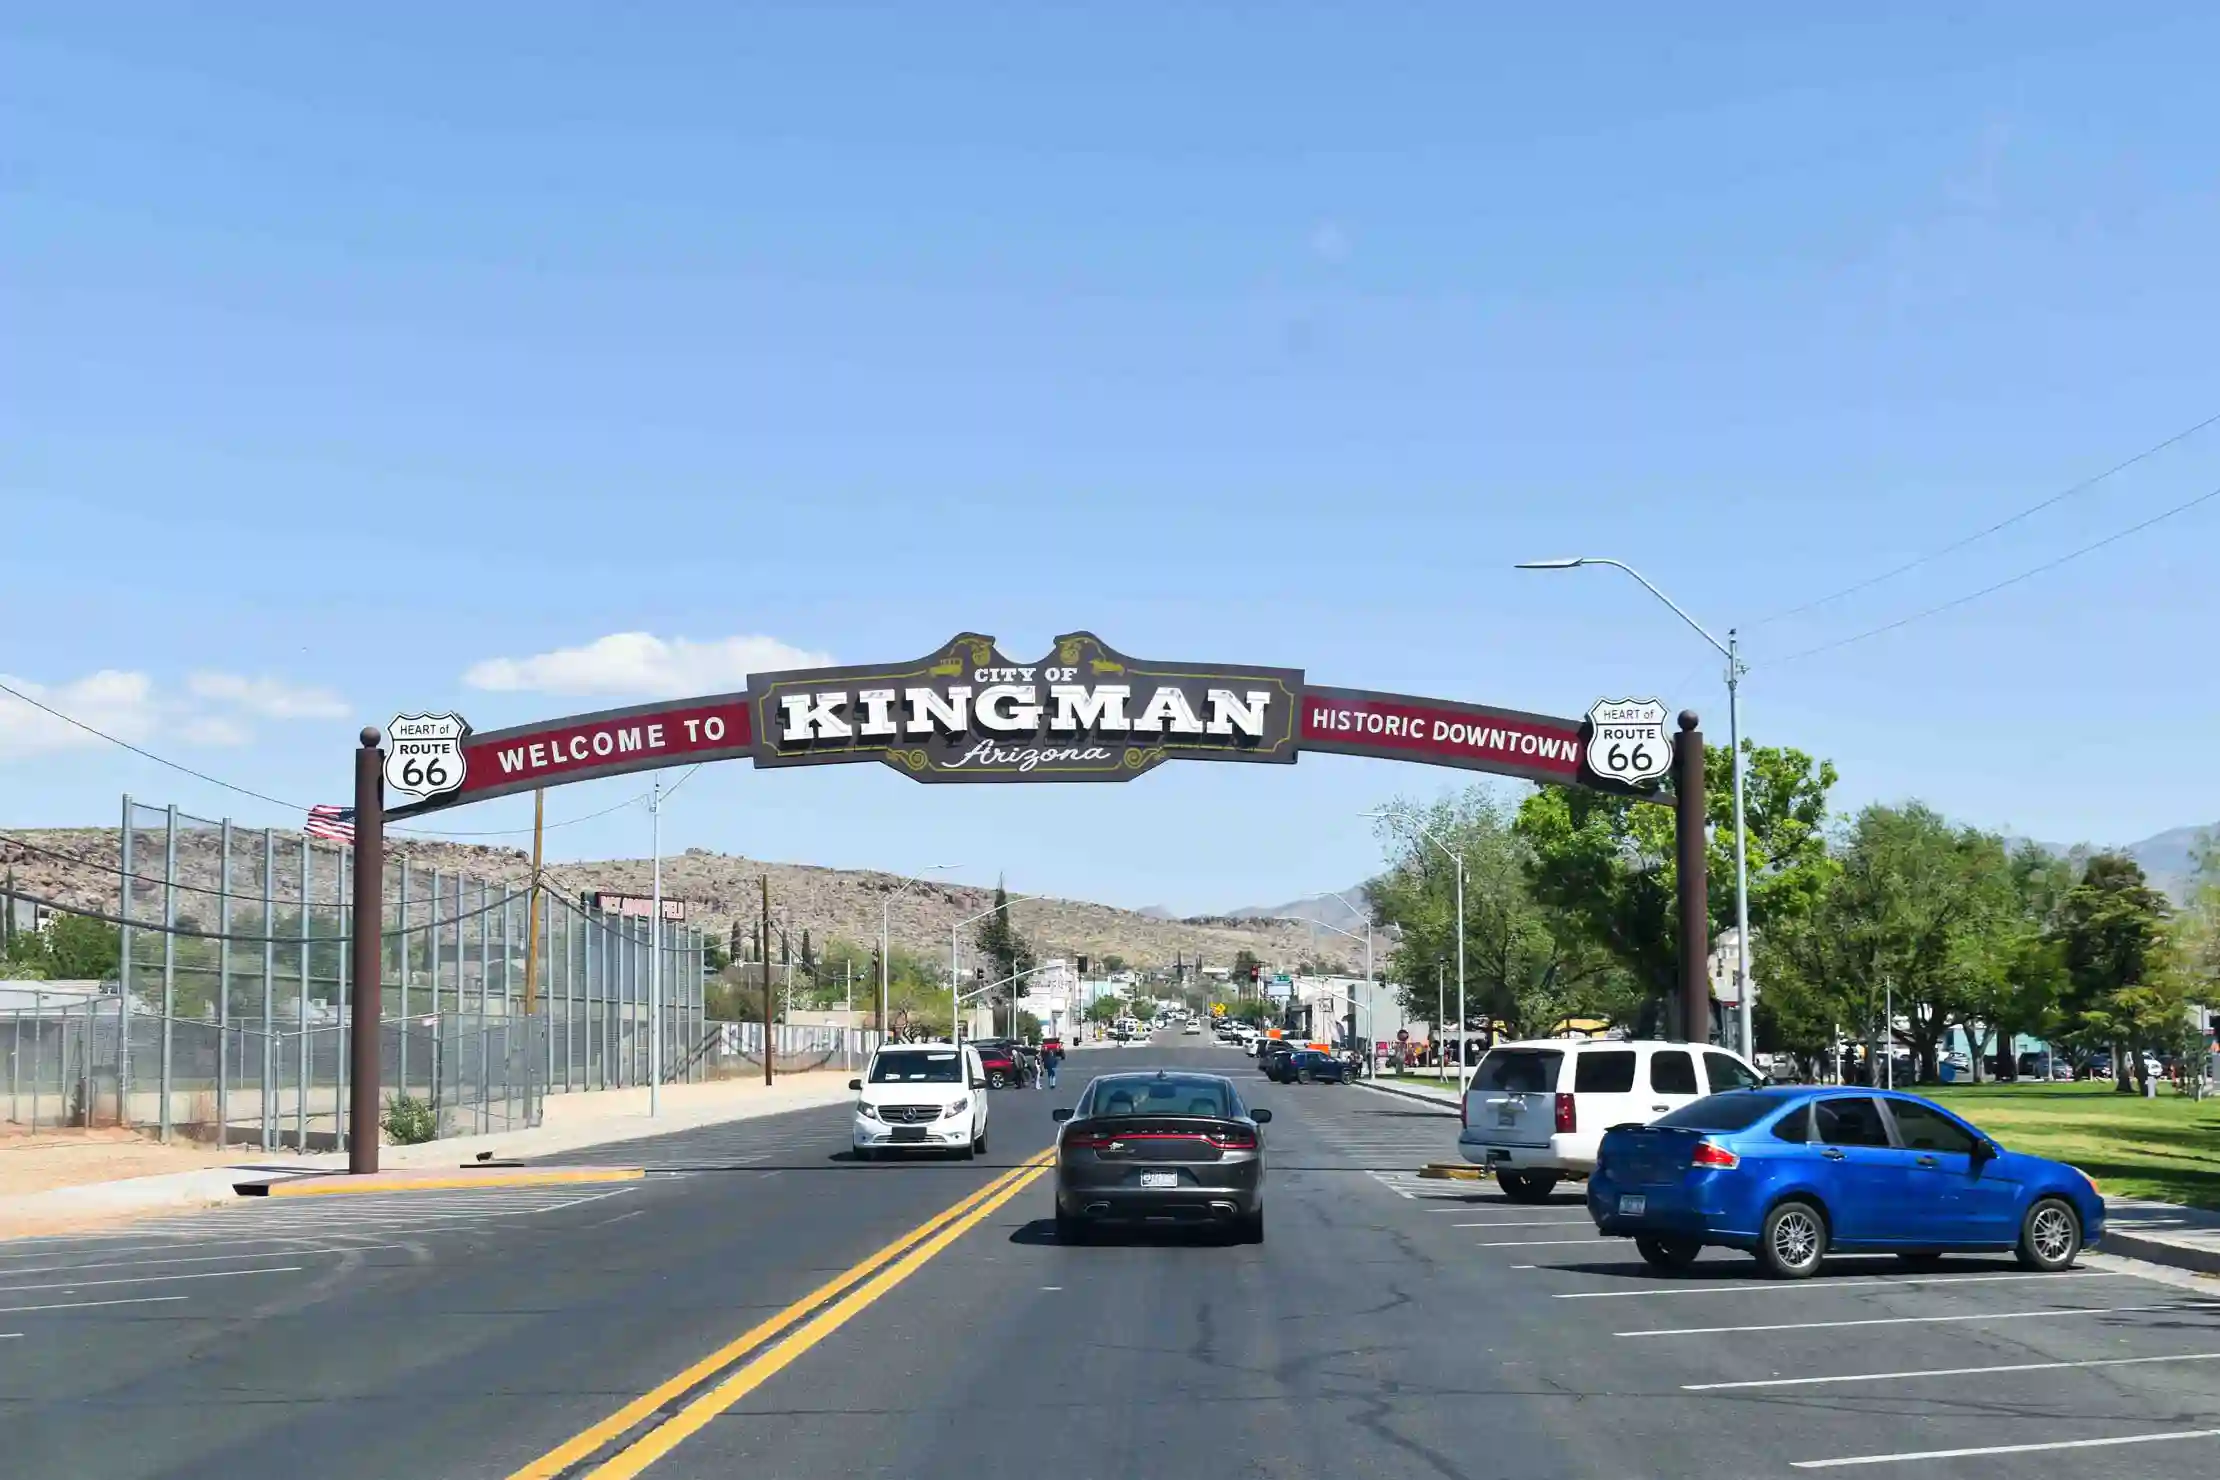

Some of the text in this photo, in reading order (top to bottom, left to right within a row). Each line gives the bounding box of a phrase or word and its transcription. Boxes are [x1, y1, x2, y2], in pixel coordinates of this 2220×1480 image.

[974, 667, 1078, 683] CITY OF
[781, 684, 1271, 741] KINGMAN
[1603, 708, 1655, 720] HEART of
[400, 723, 450, 735] HEART of
[1312, 708, 1578, 763] HISTORIC DOWNTOWN
[1603, 728, 1656, 740] ROUTE
[399, 743, 451, 755] ROUTE
[498, 715, 726, 774] WELCOME TO
[941, 738, 1112, 772] Arizona
[1607, 742, 1653, 772] 66
[402, 757, 448, 787] 66
